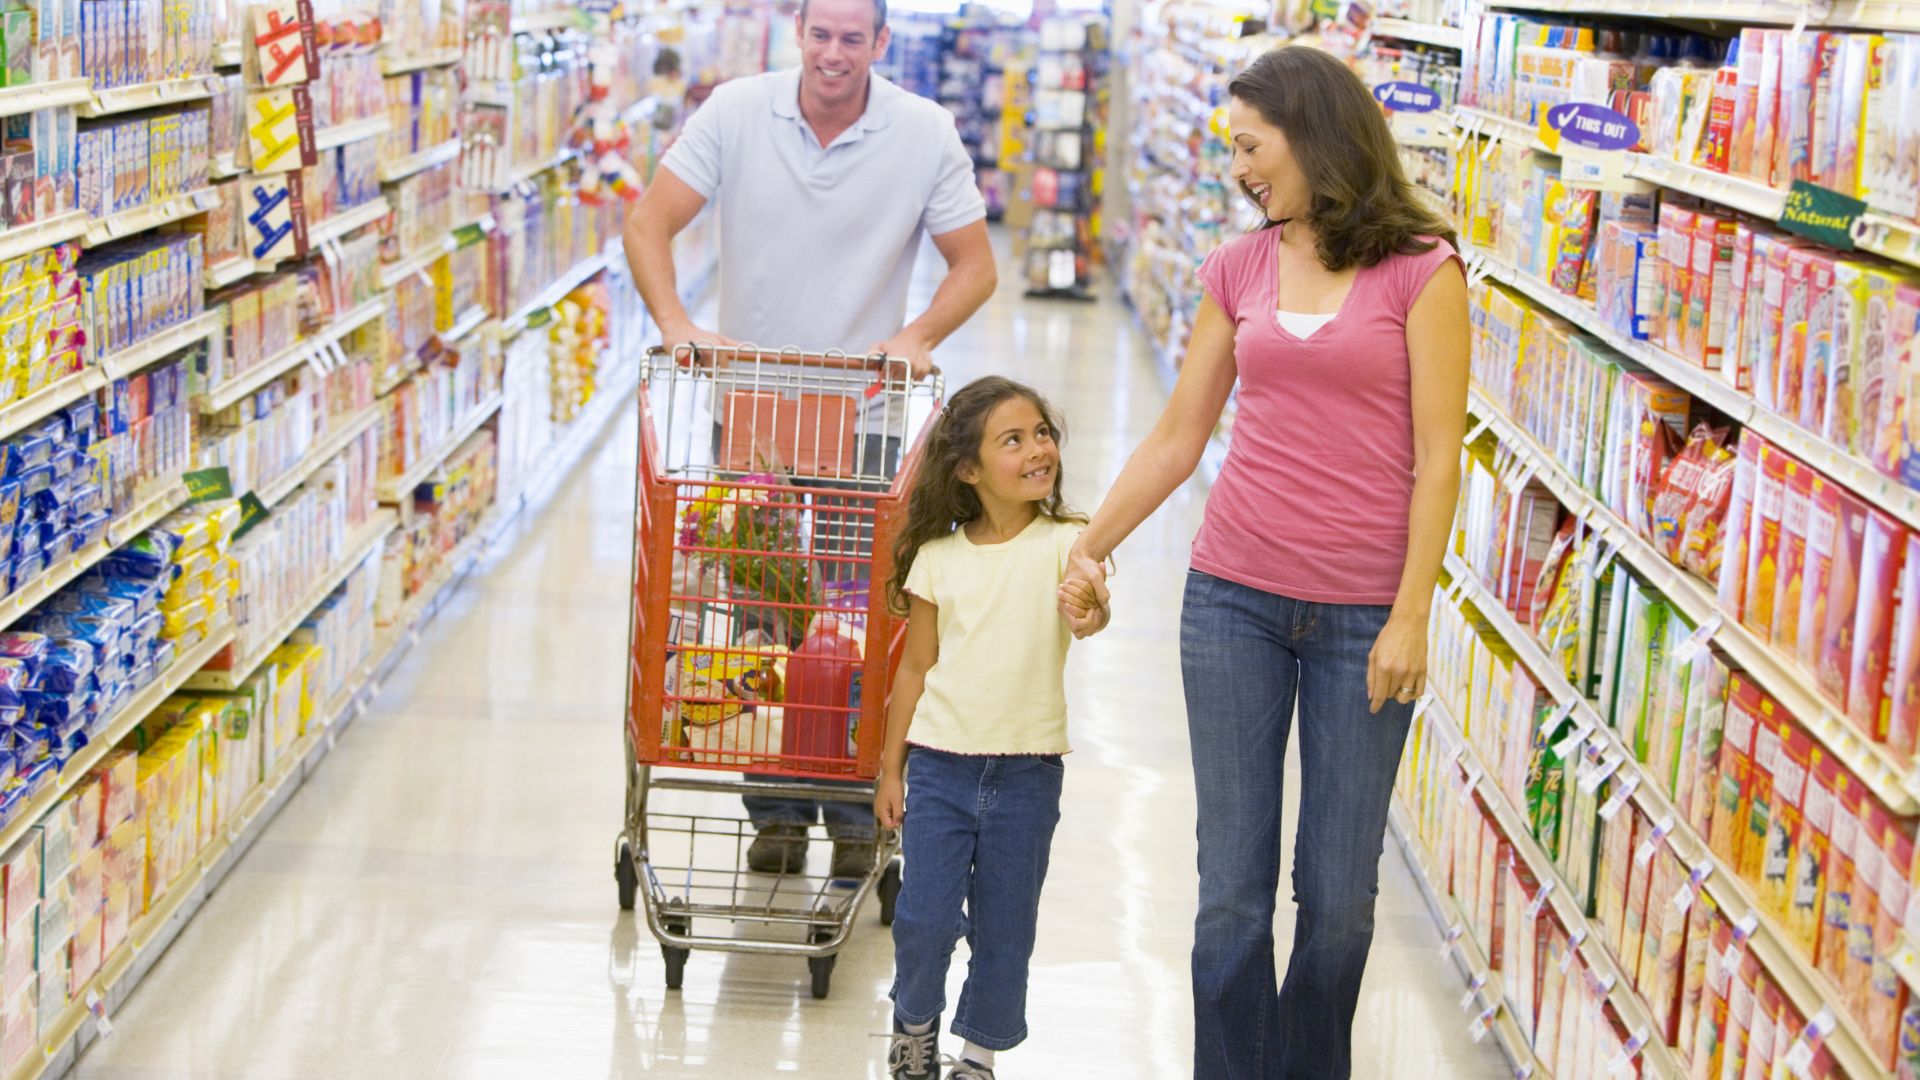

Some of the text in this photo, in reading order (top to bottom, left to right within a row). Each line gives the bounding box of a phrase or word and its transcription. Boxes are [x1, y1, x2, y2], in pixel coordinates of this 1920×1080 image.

[1575, 114, 1628, 140] THIS OUT
[1784, 206, 1850, 230] Natural
